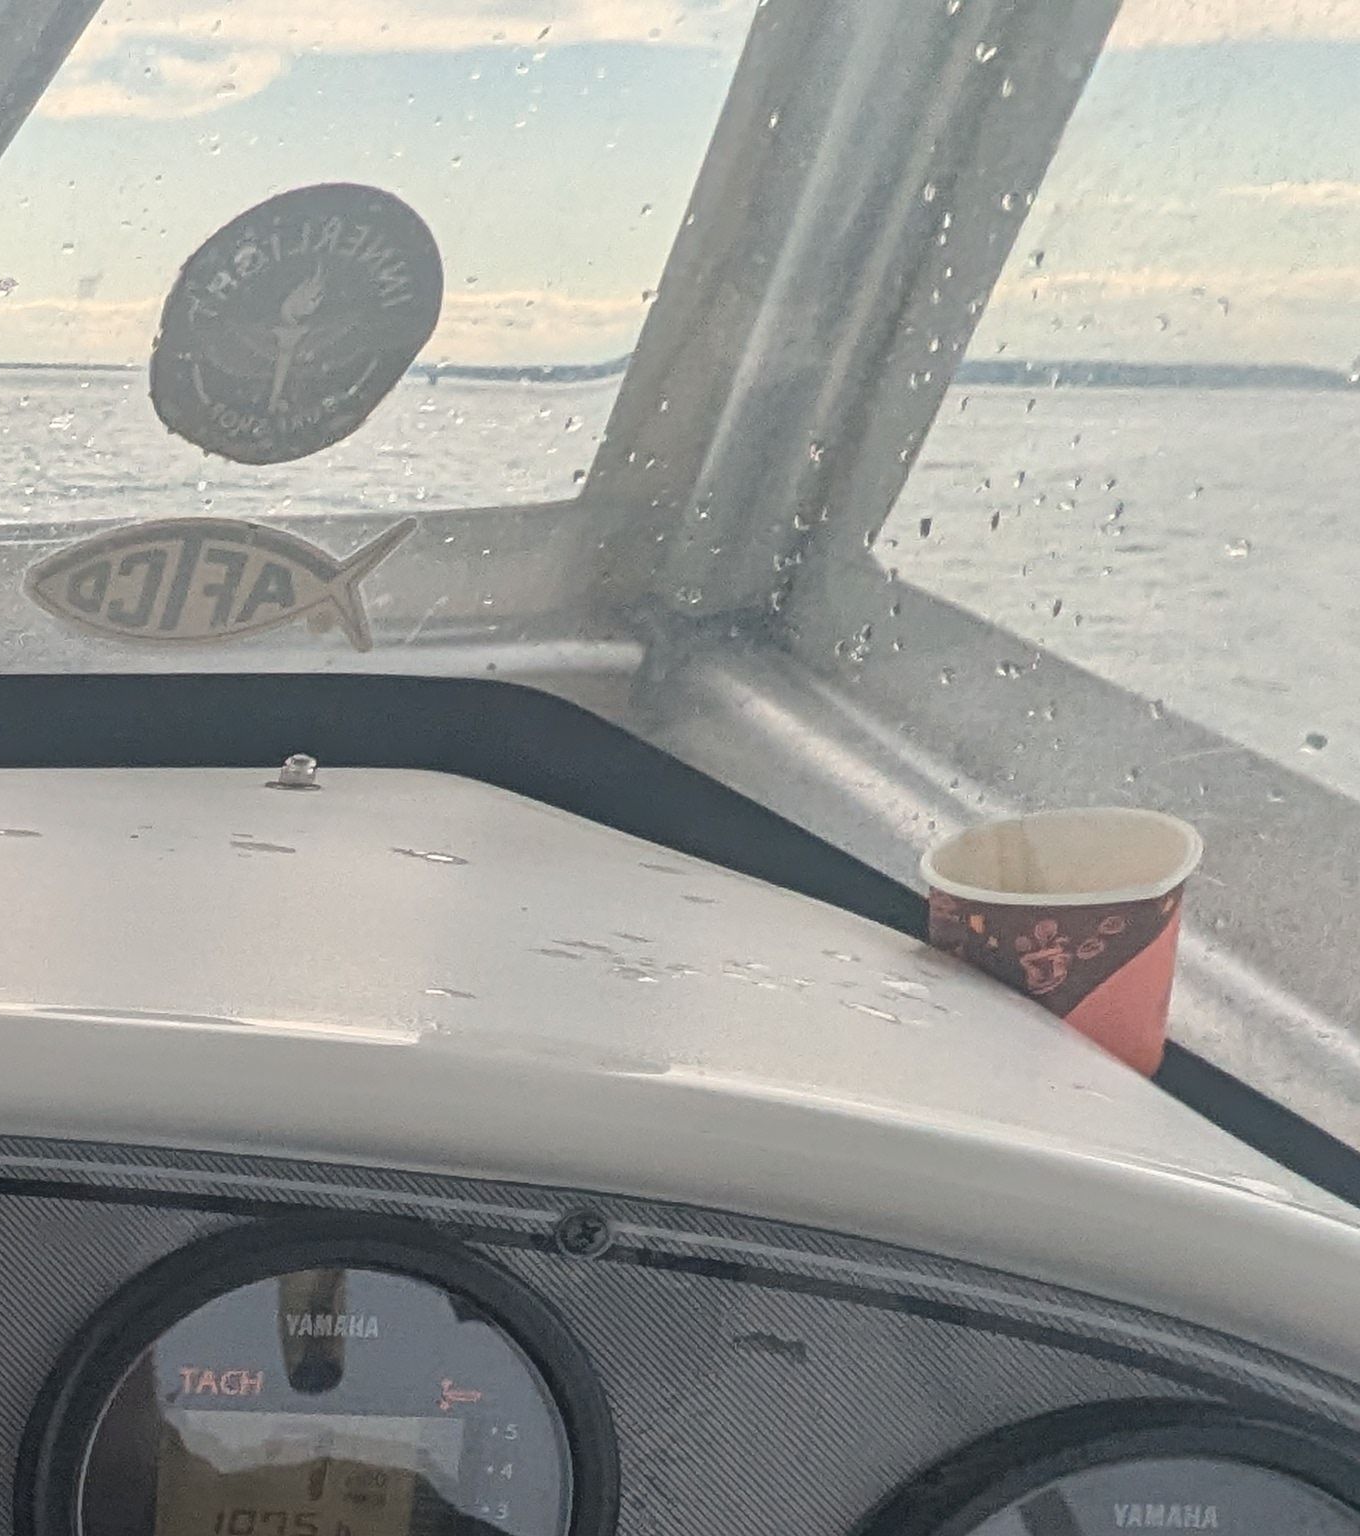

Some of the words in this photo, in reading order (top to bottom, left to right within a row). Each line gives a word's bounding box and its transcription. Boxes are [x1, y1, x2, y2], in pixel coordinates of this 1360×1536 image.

[285, 1312, 380, 1339] YAMAHA
[180, 1366, 265, 1396] TACH
[503, 1423, 519, 1440] 5
[499, 1463, 513, 1480] 4
[495, 1503, 509, 1519] 3
[1113, 1502, 1219, 1529] YAMAHA
